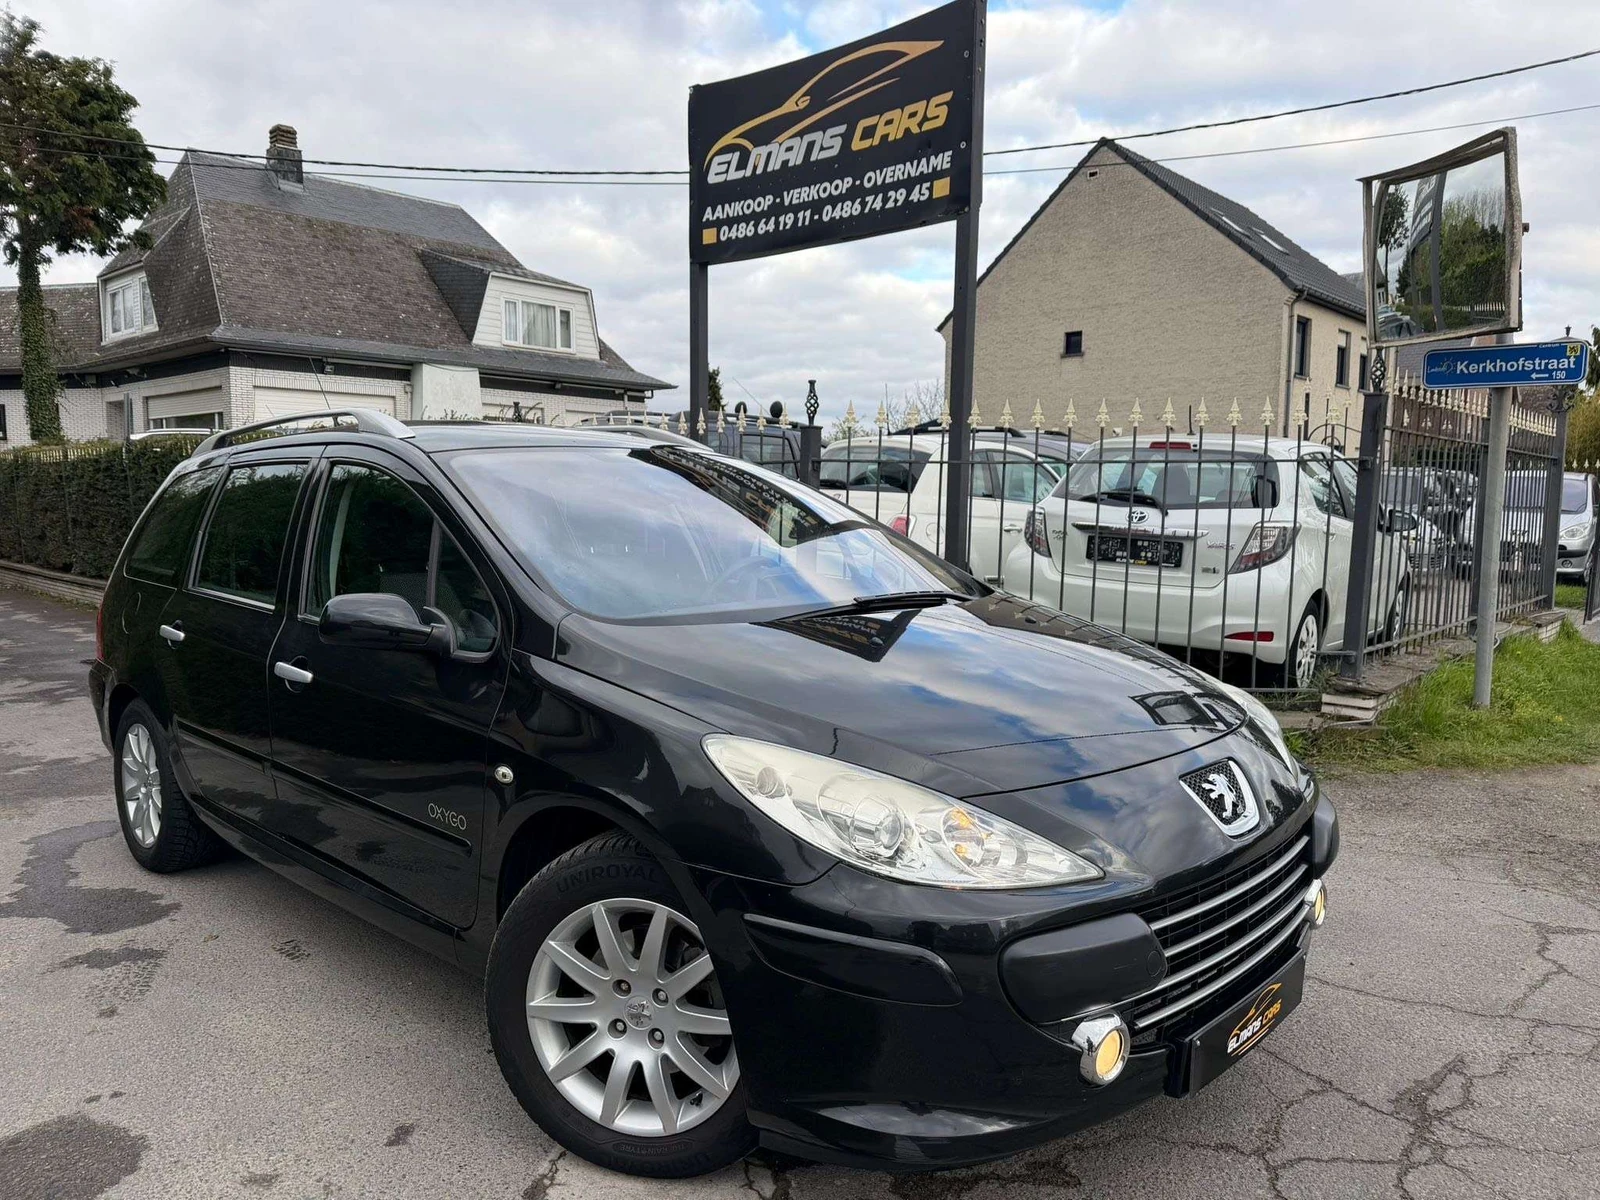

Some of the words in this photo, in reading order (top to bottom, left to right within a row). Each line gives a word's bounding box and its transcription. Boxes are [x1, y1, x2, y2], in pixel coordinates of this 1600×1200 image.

[707, 124, 847, 184] ELMANS
[851, 90, 954, 151] CARS
[702, 194, 775, 222] AANKOOP
[783, 177, 852, 206] VERKOOP
[863, 150, 953, 188] OVERNAME
[719, 221, 754, 241] 0486
[757, 216, 775, 235] 64
[778, 213, 794, 231] 19
[797, 210, 811, 227] 11
[822, 198, 861, 222] 0486
[865, 193, 882, 211] 74
[885, 187, 906, 208] 29
[909, 182, 930, 203] 45
[1456, 356, 1576, 374] Kerkhofstraat
[1551, 370, 1566, 379] 150
[428, 803, 467, 830] OXYGO
[556, 864, 660, 893] UNIROYAL
[1227, 1016, 1262, 1053] ELMANS
[1262, 998, 1282, 1025] CARS
